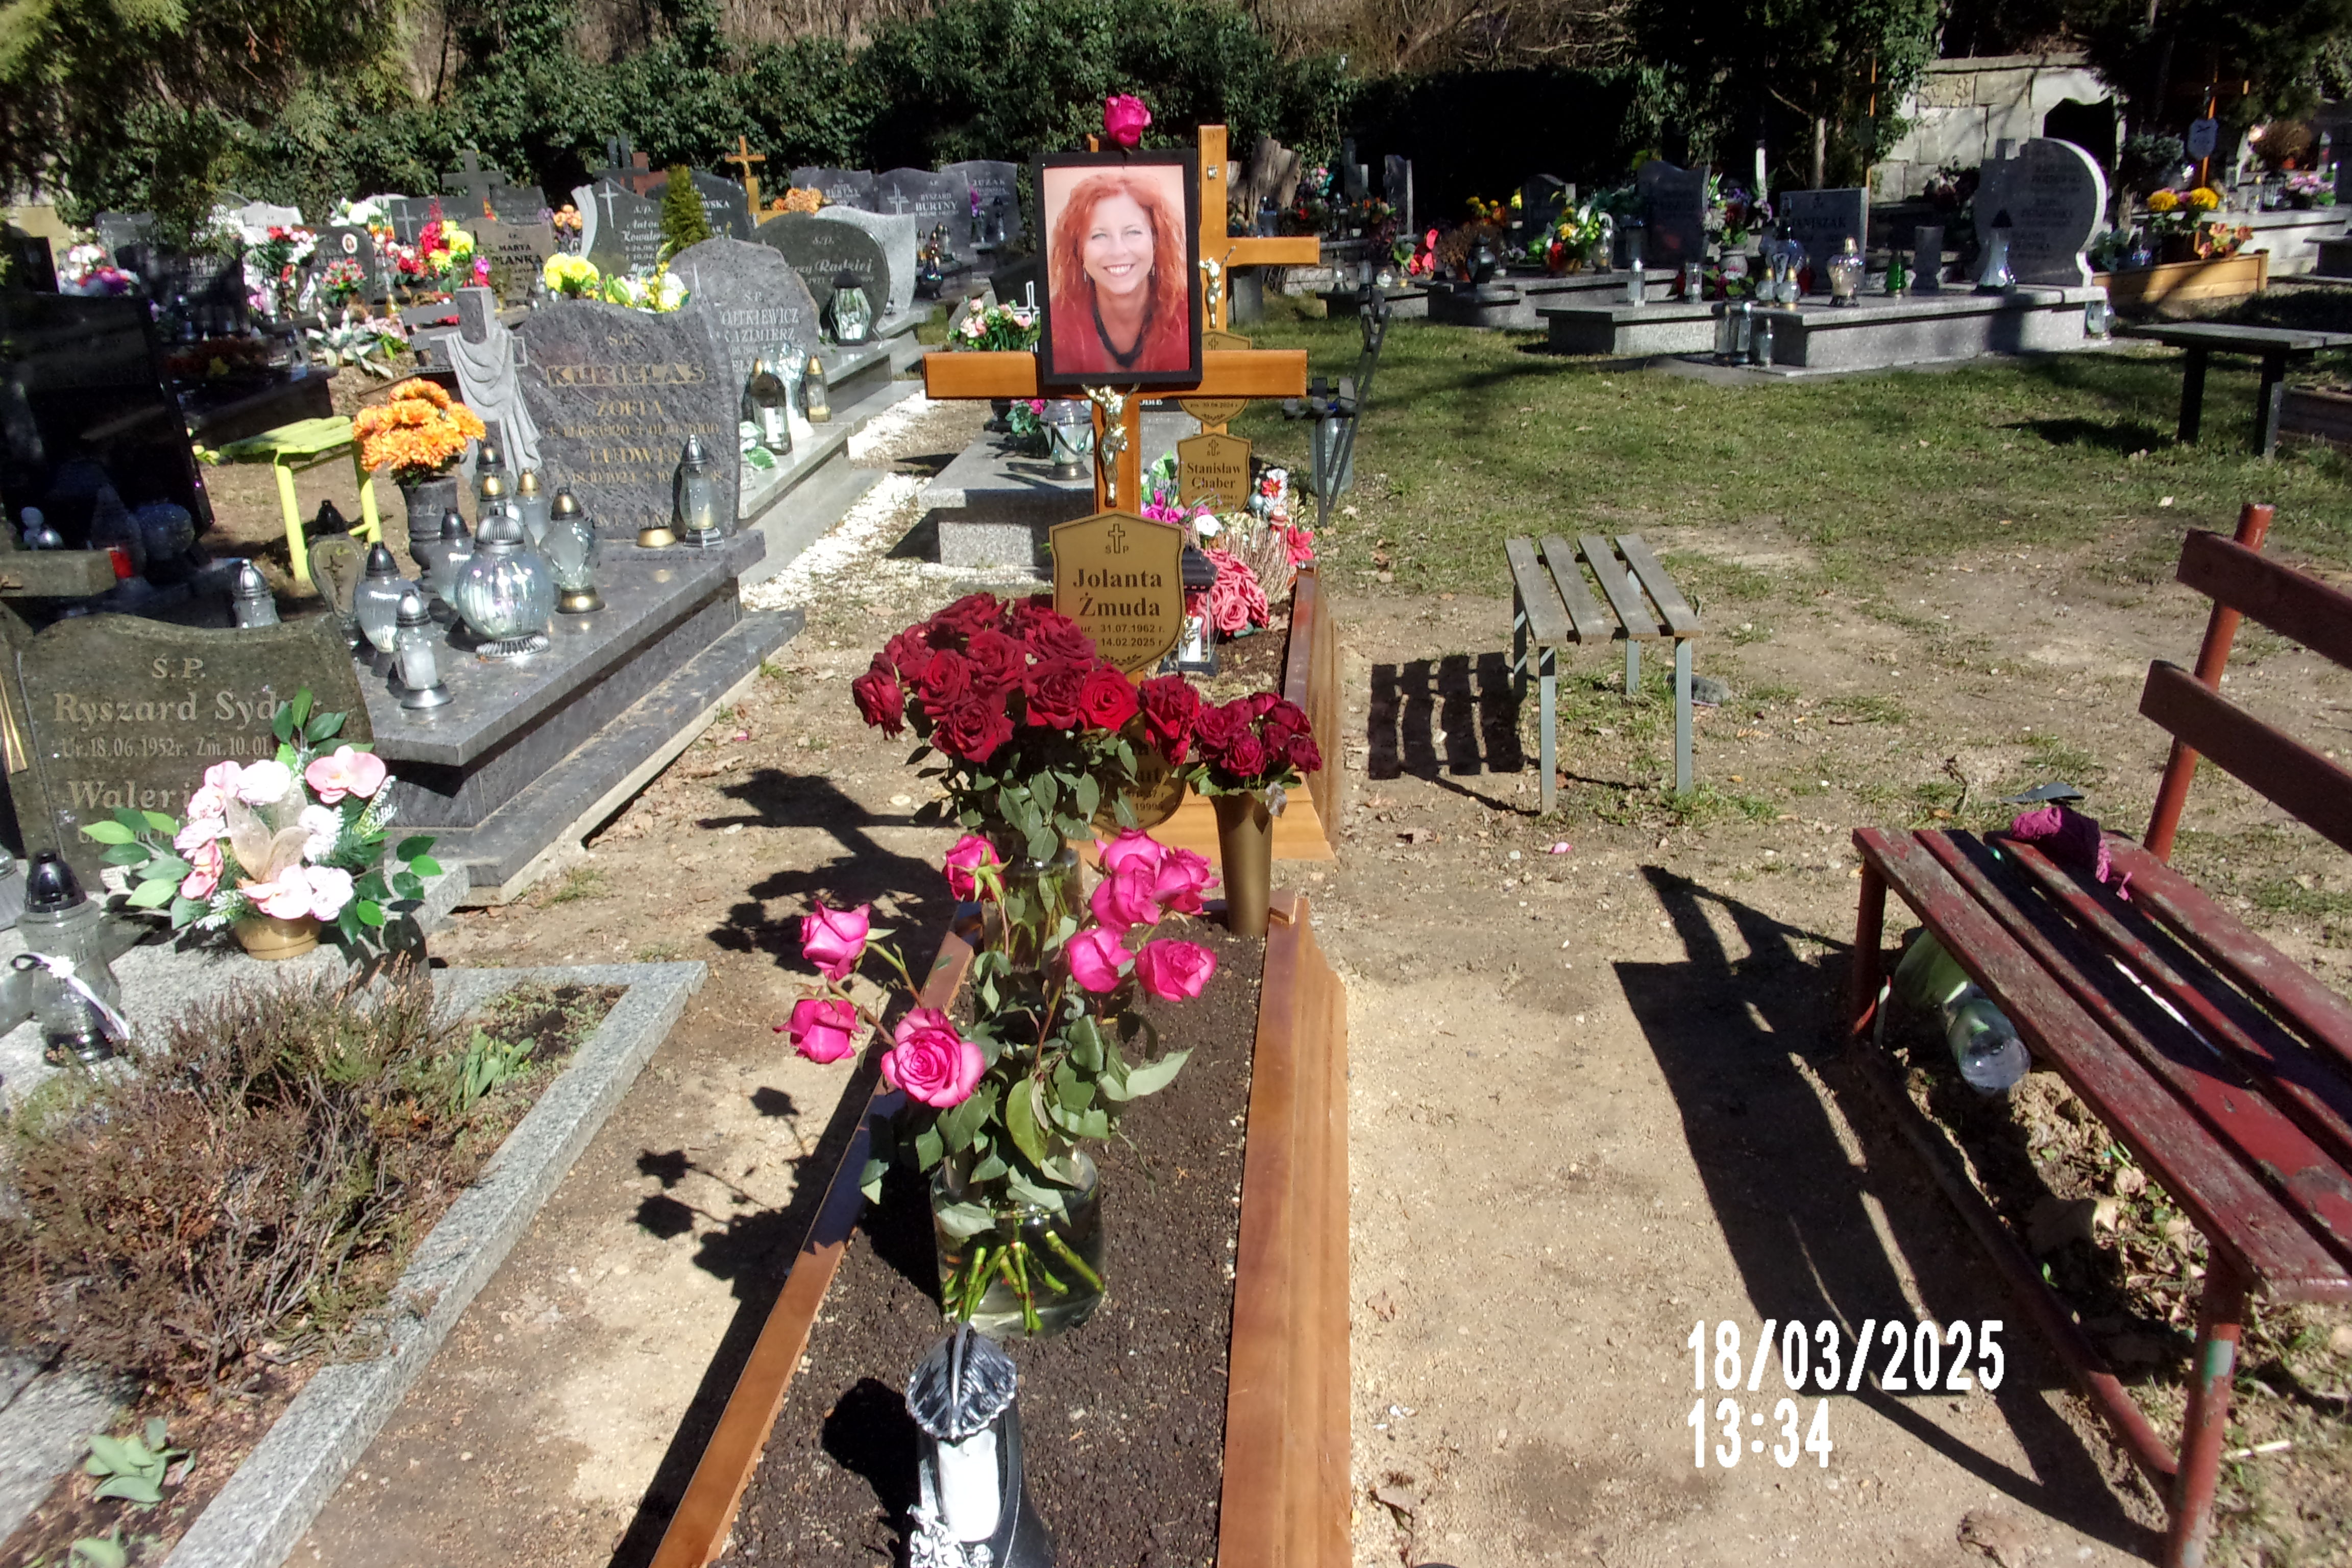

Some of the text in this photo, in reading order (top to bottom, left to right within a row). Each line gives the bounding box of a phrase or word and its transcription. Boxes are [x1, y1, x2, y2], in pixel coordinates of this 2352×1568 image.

[915, 202, 958, 212] BURTNY
[720, 307, 800, 325] ÓJTKIEWICZ
[596, 399, 663, 416] ZOFIA
[1187, 462, 1240, 474] Stanisław
[1191, 476, 1236, 489] Chaber
[1073, 568, 1162, 587] Jolanta
[1079, 592, 1161, 617] Żmuda
[1100, 624, 1156, 633] 31.07.1962
[1101, 638, 1156, 647] 14.02.2025
[53, 690, 323, 731] Ryszard Sydr
[67, 780, 194, 809] Waleri
